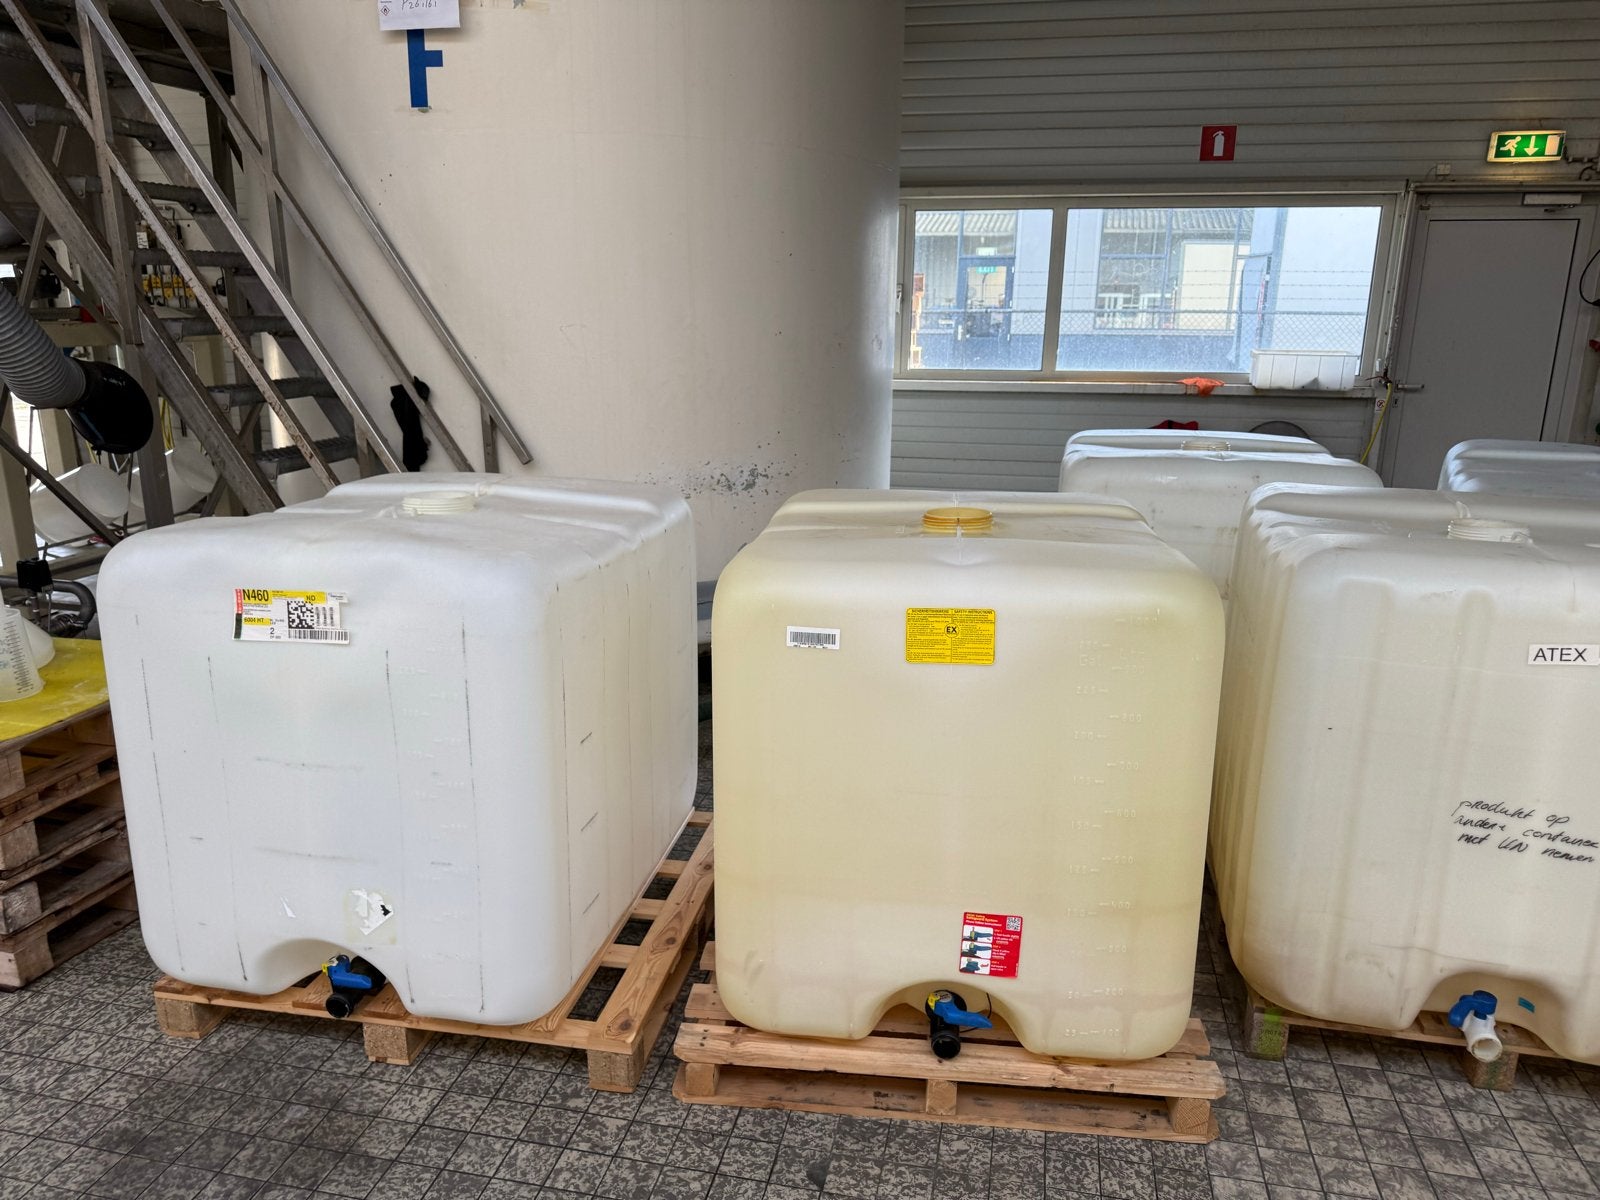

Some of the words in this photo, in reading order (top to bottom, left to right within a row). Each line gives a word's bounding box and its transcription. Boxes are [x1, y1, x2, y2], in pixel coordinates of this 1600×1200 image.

[242, 588, 269, 602] N460
[946, 626, 957, 634] EX
[1533, 647, 1587, 662] ATEX
[1451, 800, 1535, 818] produkt
[1546, 814, 1570, 828] op
[1457, 833, 1491, 845] met
